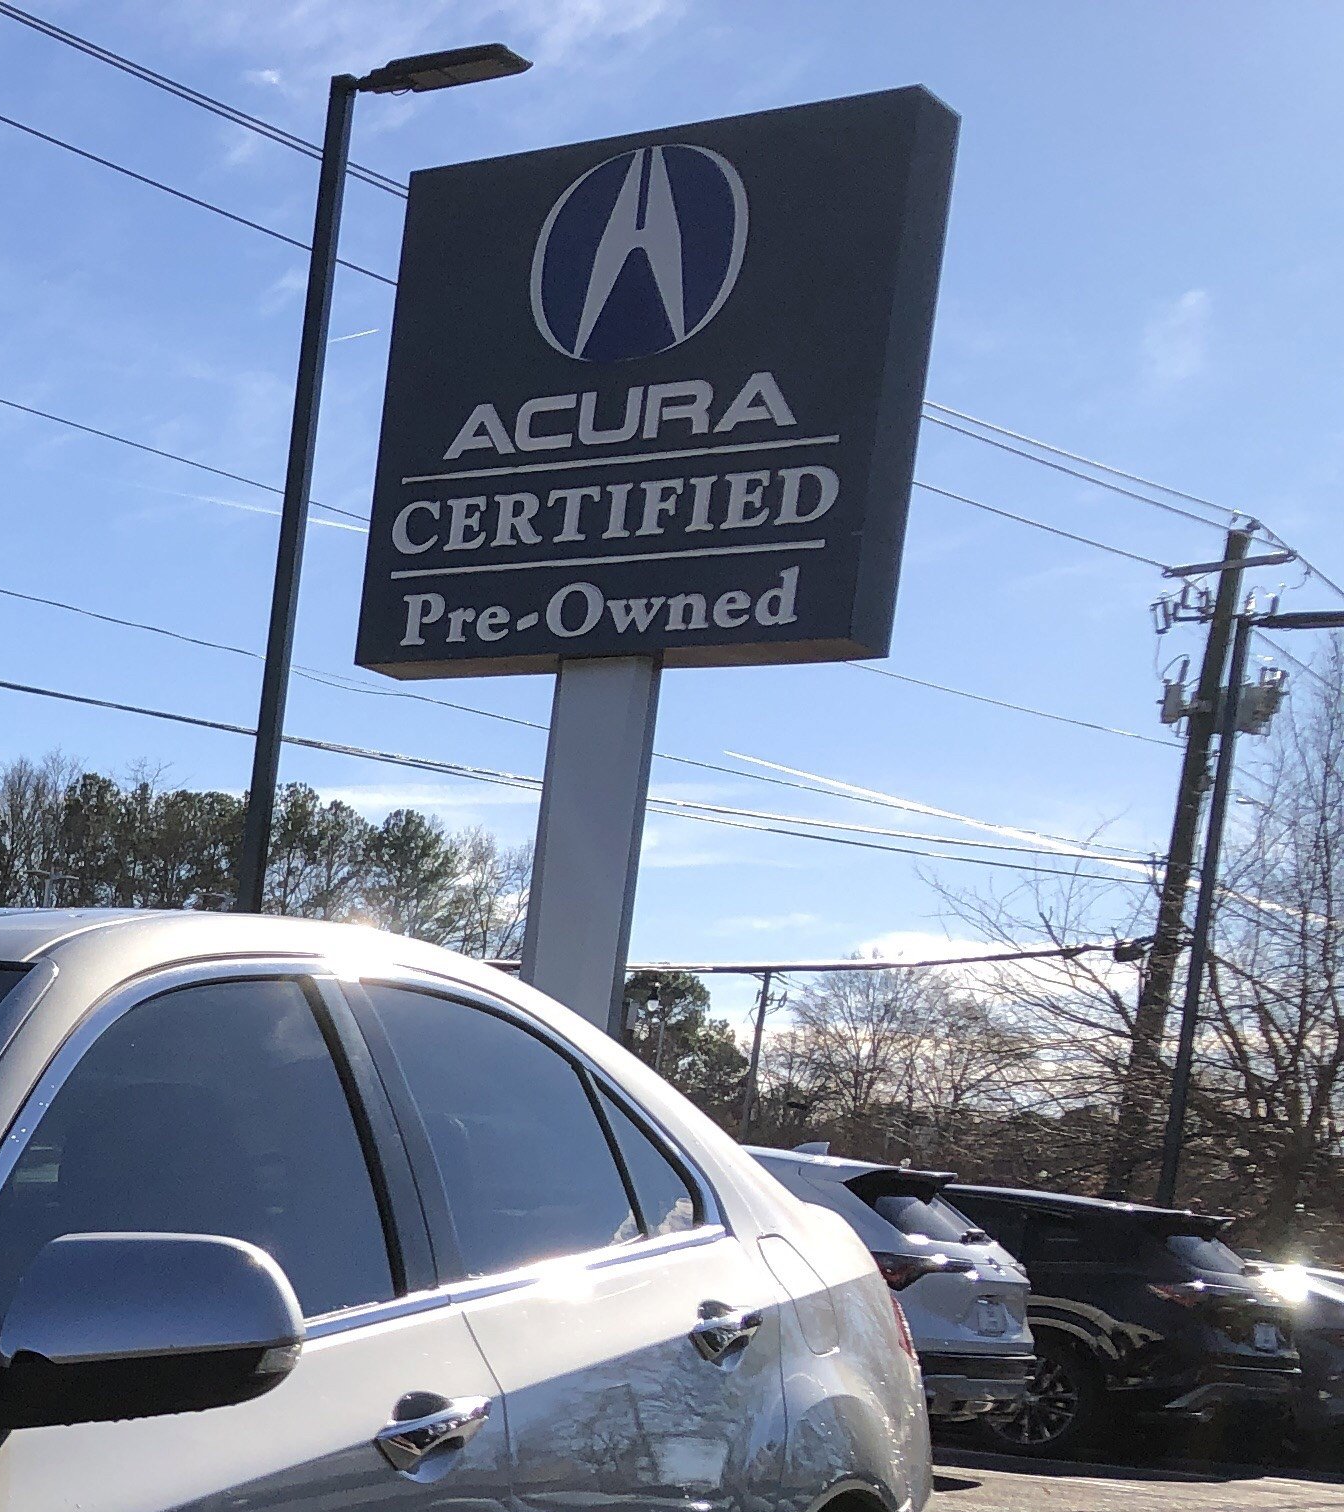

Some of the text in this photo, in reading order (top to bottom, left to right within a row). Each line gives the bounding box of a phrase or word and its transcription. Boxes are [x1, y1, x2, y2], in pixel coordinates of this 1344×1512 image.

[443, 371, 798, 460] ACURA
[390, 464, 840, 556] CERTIFIED
[399, 566, 800, 647] Pre-Owned
